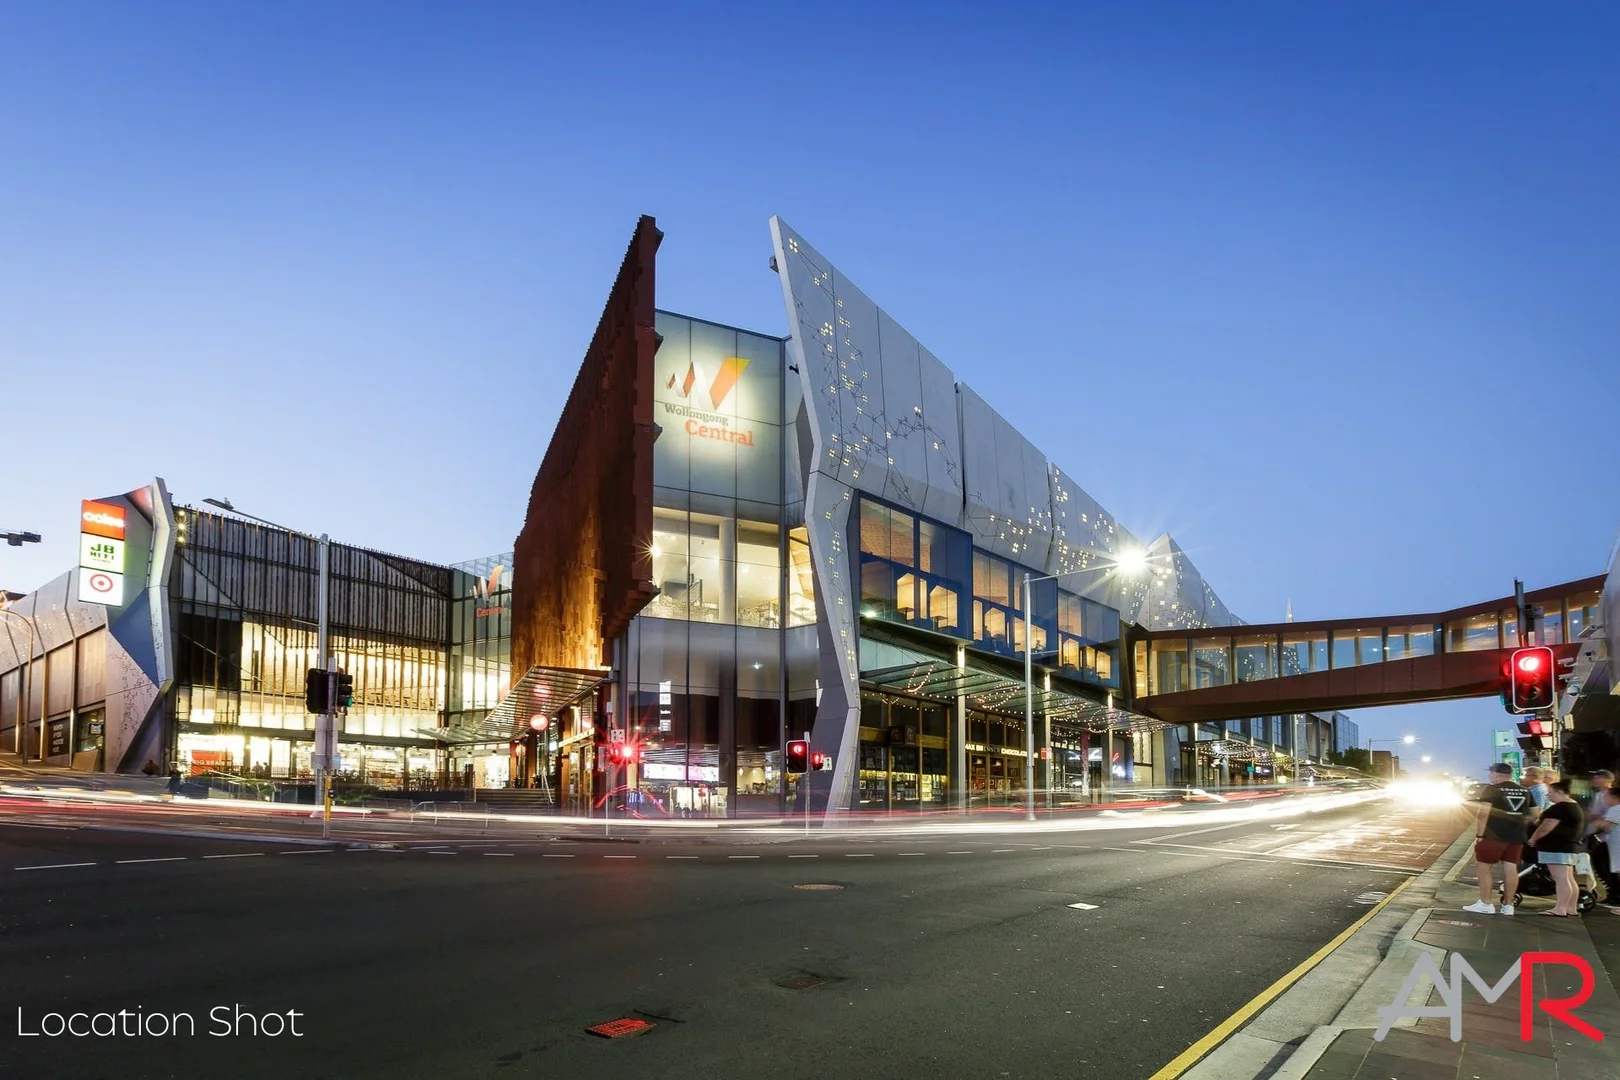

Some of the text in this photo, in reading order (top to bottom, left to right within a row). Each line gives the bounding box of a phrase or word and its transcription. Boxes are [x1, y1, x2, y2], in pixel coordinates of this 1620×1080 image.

[664, 402, 729, 427] Wollongong
[684, 419, 755, 448] Central
[90, 543, 114, 554] JB
